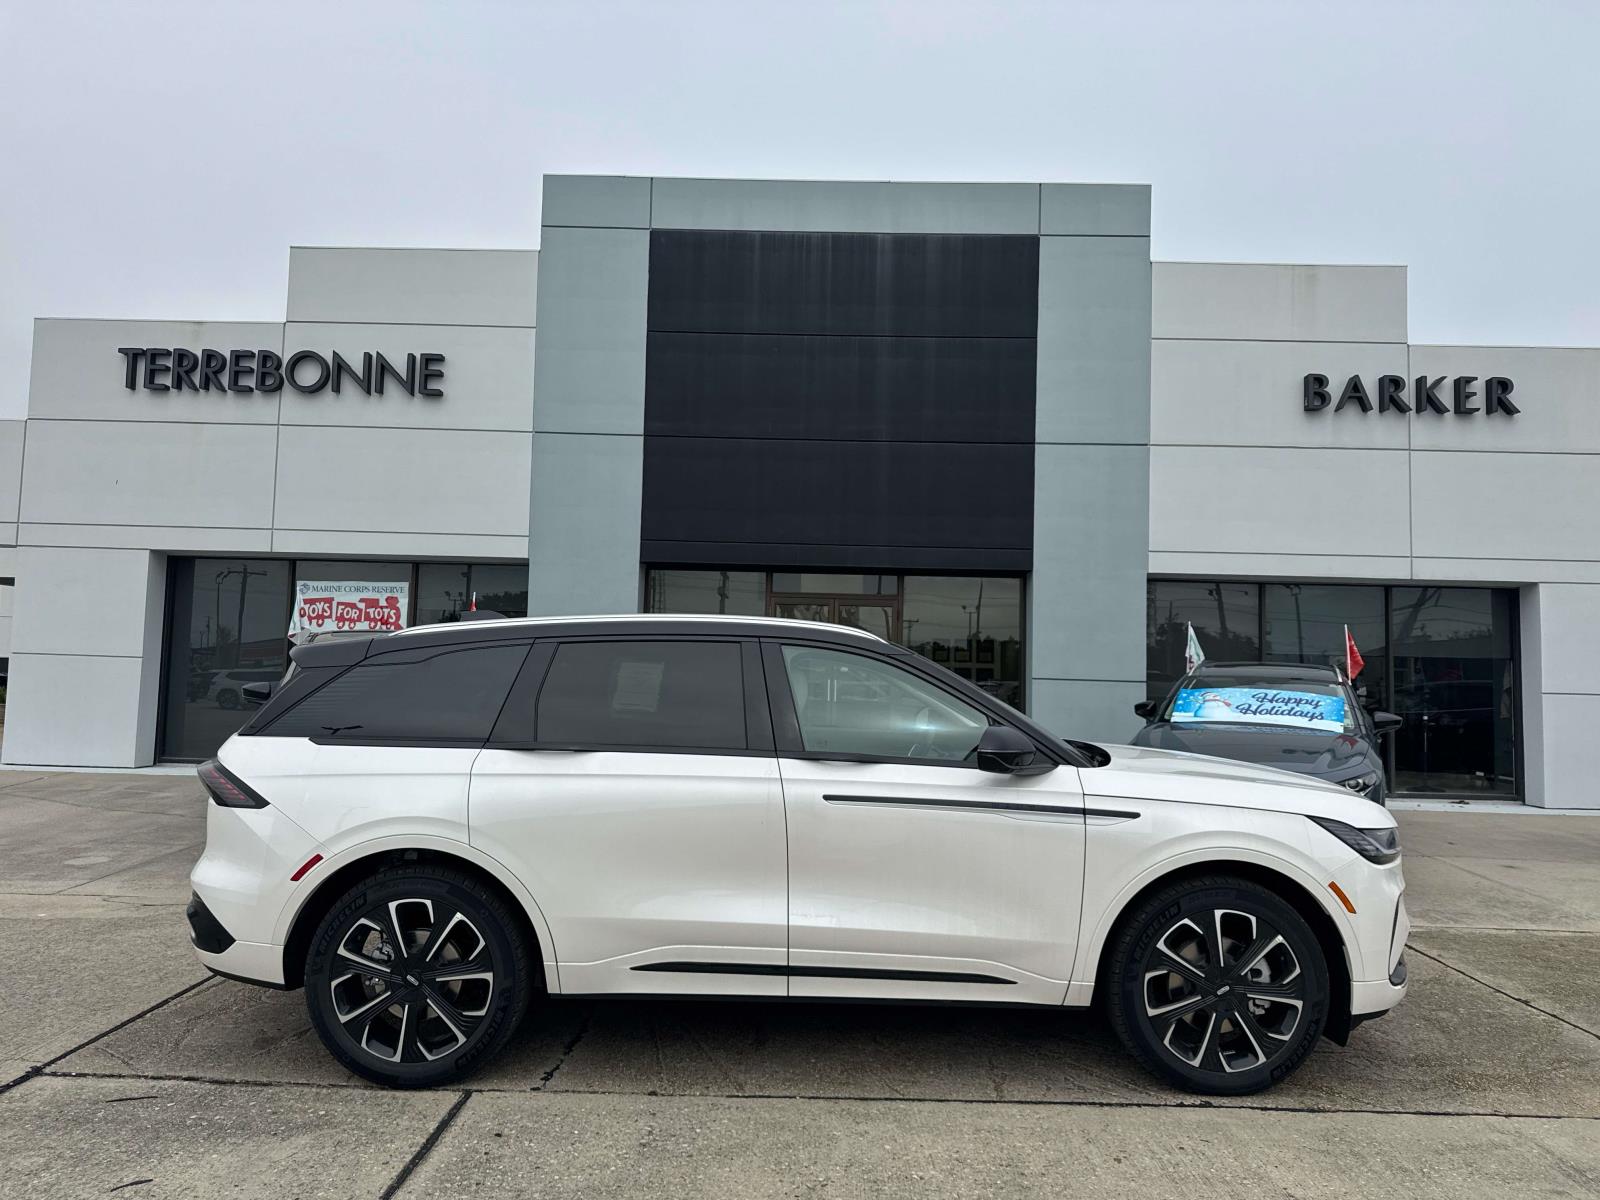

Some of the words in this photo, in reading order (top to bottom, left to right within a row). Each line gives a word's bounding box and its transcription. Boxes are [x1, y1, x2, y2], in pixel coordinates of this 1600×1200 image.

[118, 347, 445, 397] TERREBONNE
[1303, 373, 1522, 416] BARKER
[311, 584, 343, 593] MARINE
[343, 585, 371, 593] CORPS
[371, 585, 405, 594] RESERVE
[305, 601, 331, 617] TOYS
[337, 605, 359, 620] FOR
[366, 607, 397, 623] TOTS
[1251, 691, 1323, 711] Happy
[1235, 702, 1325, 722] Holidays
